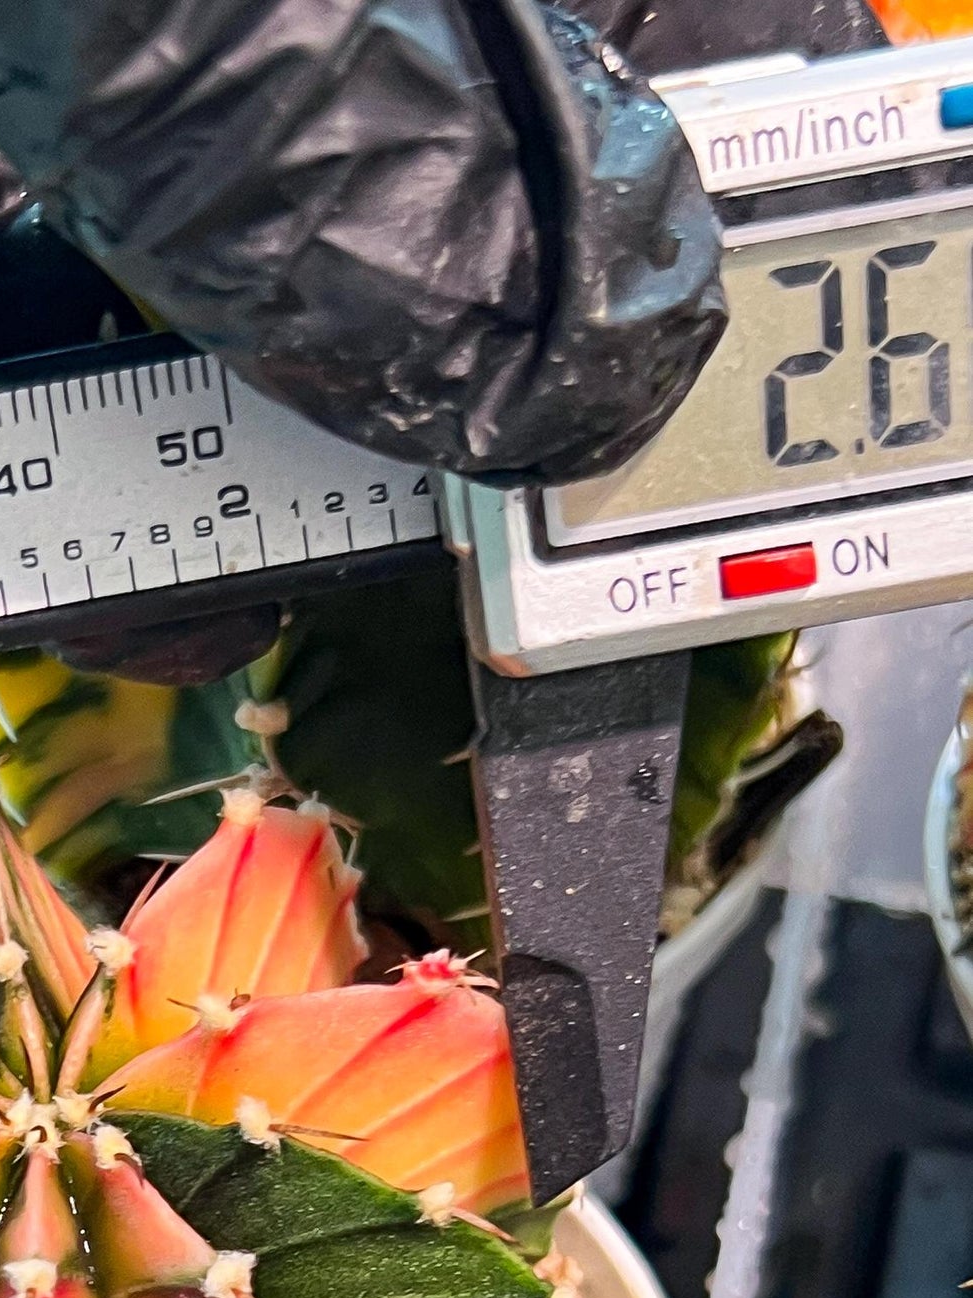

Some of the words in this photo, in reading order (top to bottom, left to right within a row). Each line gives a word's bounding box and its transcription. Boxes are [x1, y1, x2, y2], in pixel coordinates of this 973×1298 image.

[708, 94, 906, 175] mm/inch
[764, 240, 972, 467] 2.6
[155, 425, 225, 468] 50
[19, 546, 39, 569] 5
[62, 538, 83, 561] 6
[110, 530, 127, 552] 7
[148, 523, 171, 545] 8
[193, 515, 214, 539] 9
[217, 484, 252, 520] 2
[290, 498, 300, 519] 1
[323, 491, 346, 514] 2
[367, 482, 389, 505] 3
[608, 566, 689, 613] OFF
[832, 533, 890, 578] ON
